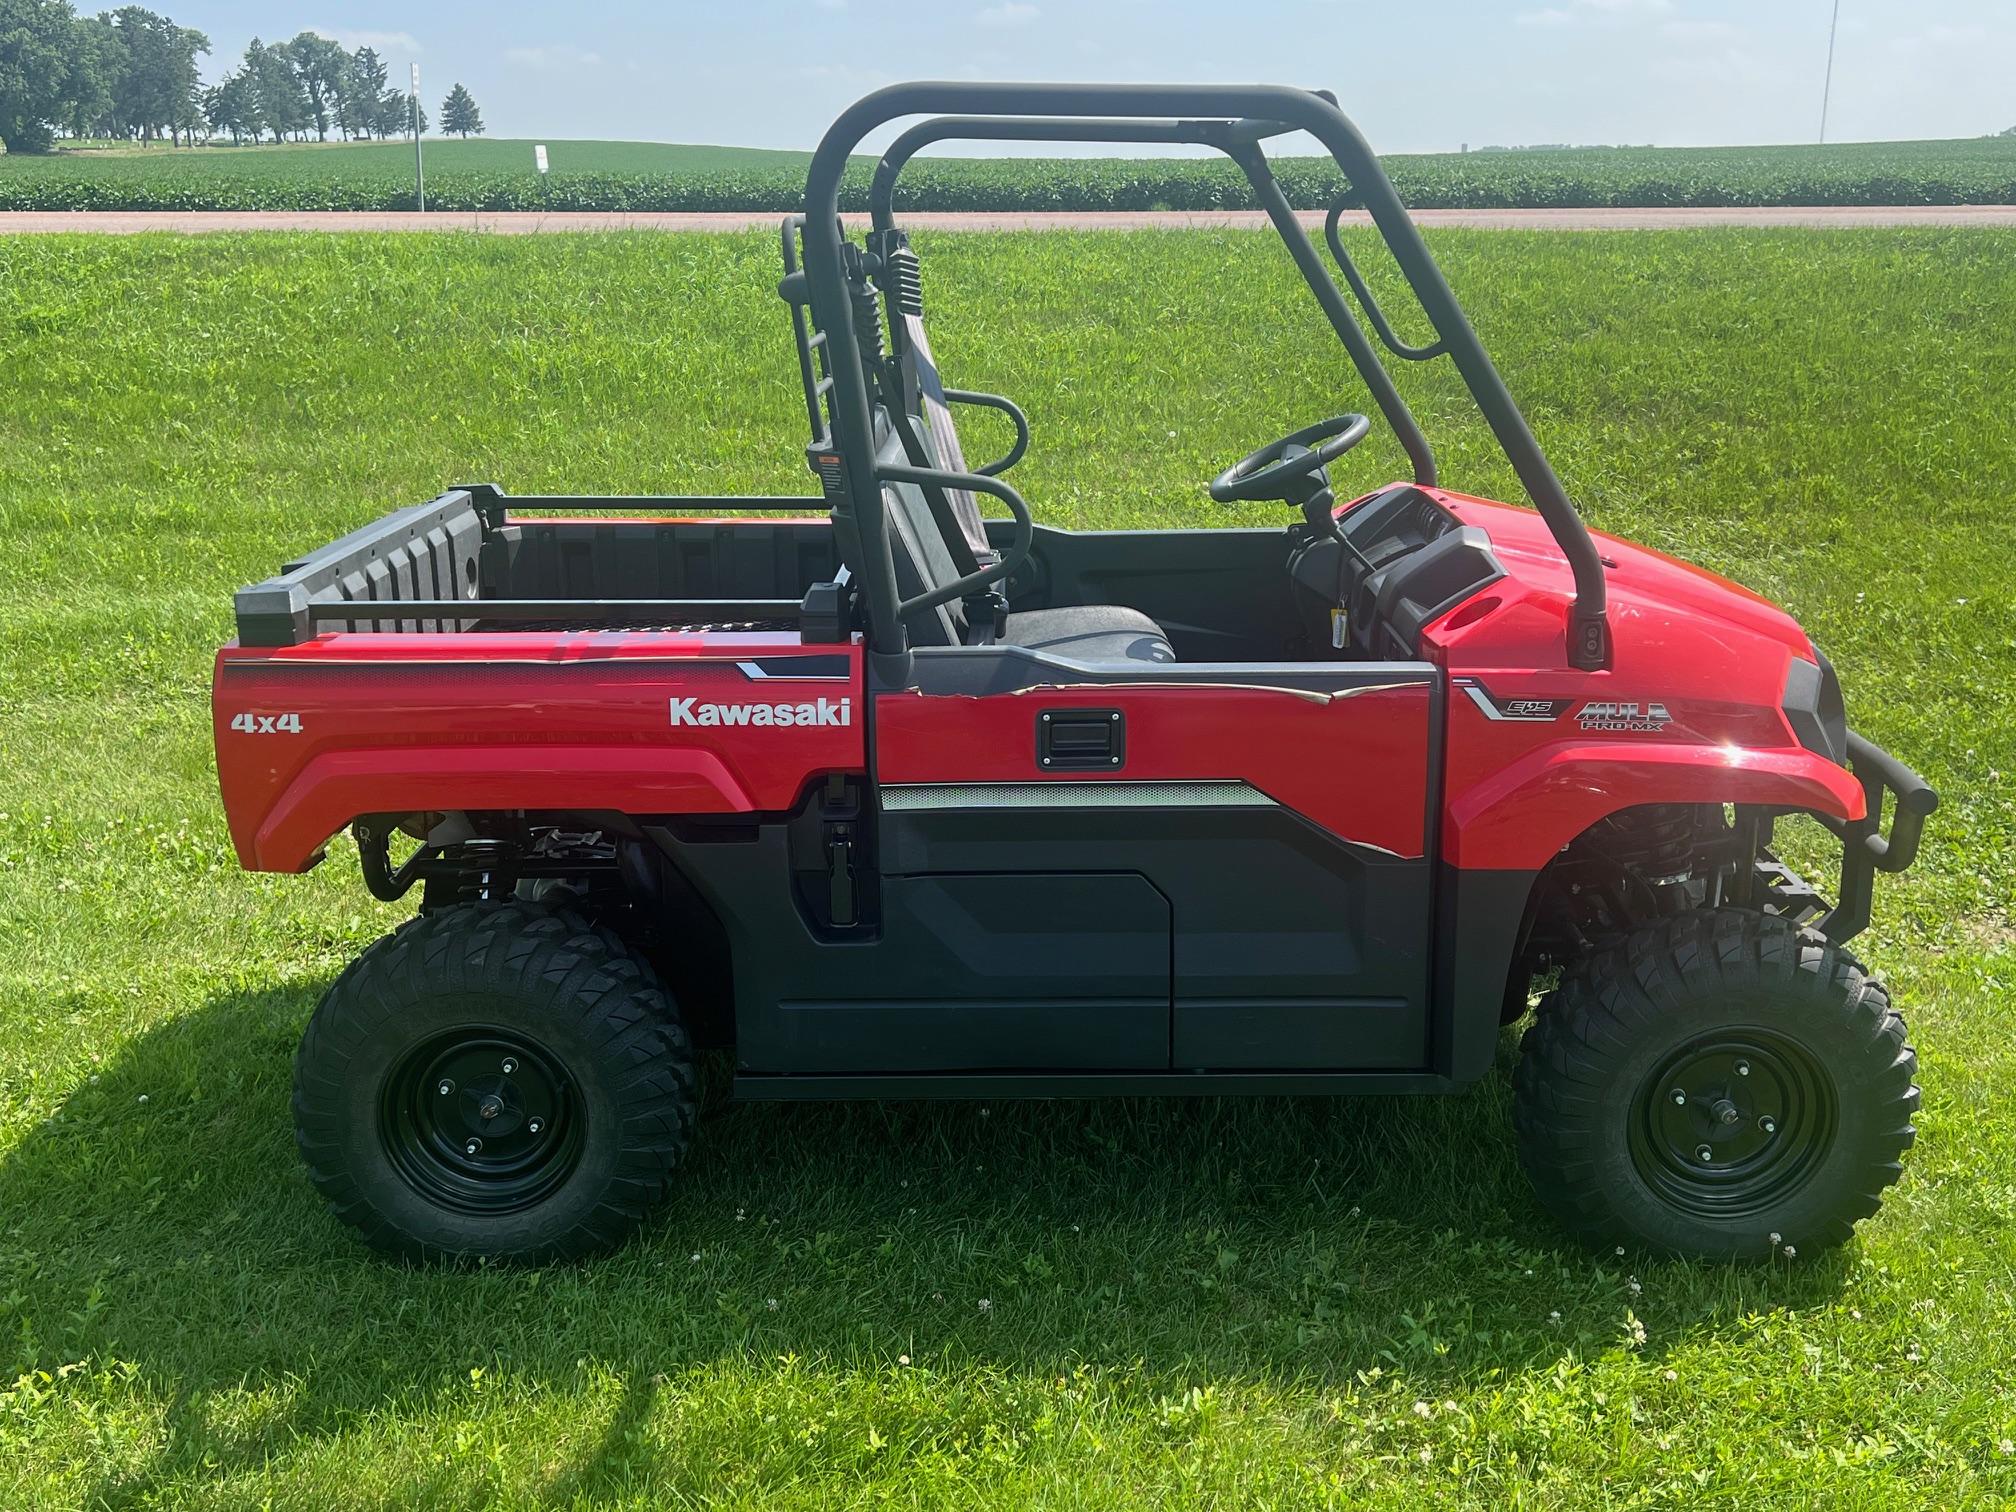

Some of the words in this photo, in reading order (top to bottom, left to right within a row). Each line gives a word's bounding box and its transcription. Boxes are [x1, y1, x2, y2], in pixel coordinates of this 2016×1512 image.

[669, 697, 851, 727] Kawasaki
[1574, 702, 1673, 722] MULE
[230, 713, 304, 734] 4x4
[1581, 721, 1664, 732] PRO-MX
